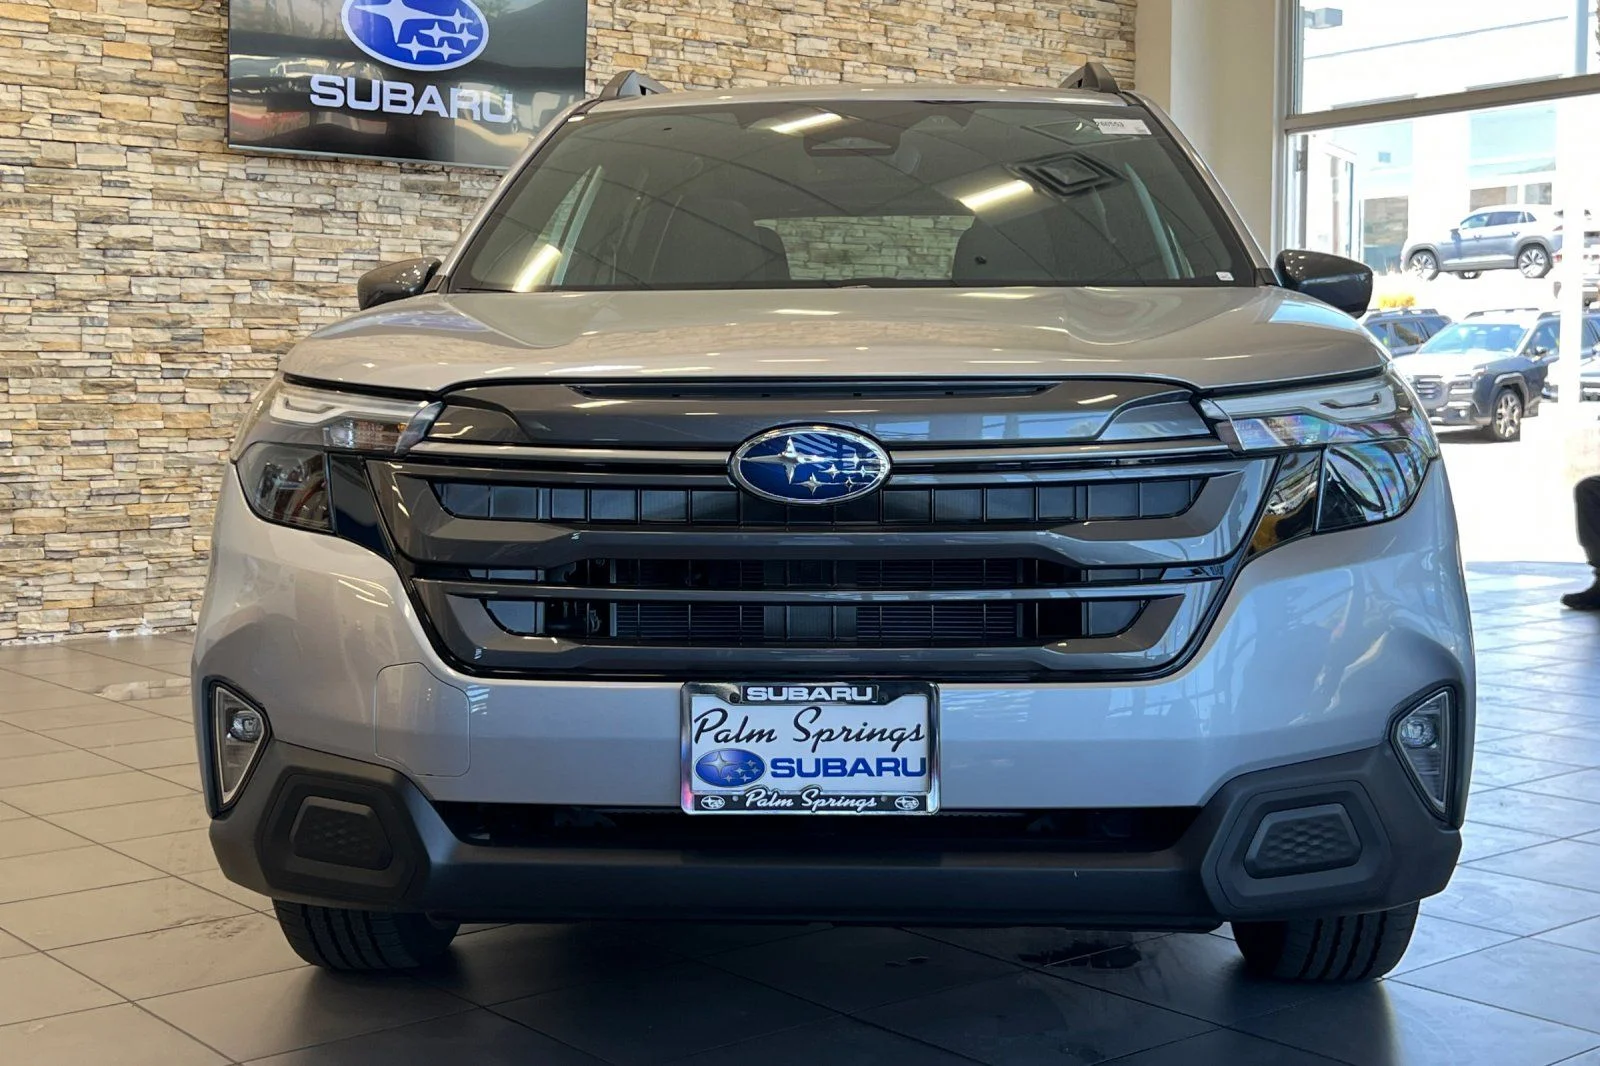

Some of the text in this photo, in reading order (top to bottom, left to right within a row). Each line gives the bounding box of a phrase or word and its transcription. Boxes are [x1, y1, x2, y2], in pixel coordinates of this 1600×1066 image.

[309, 74, 513, 123] SUBARU
[746, 686, 873, 701] SUBARU
[694, 706, 925, 753] Palm Springs
[770, 757, 927, 778] SUBARU
[745, 787, 877, 812] Palm Springs
